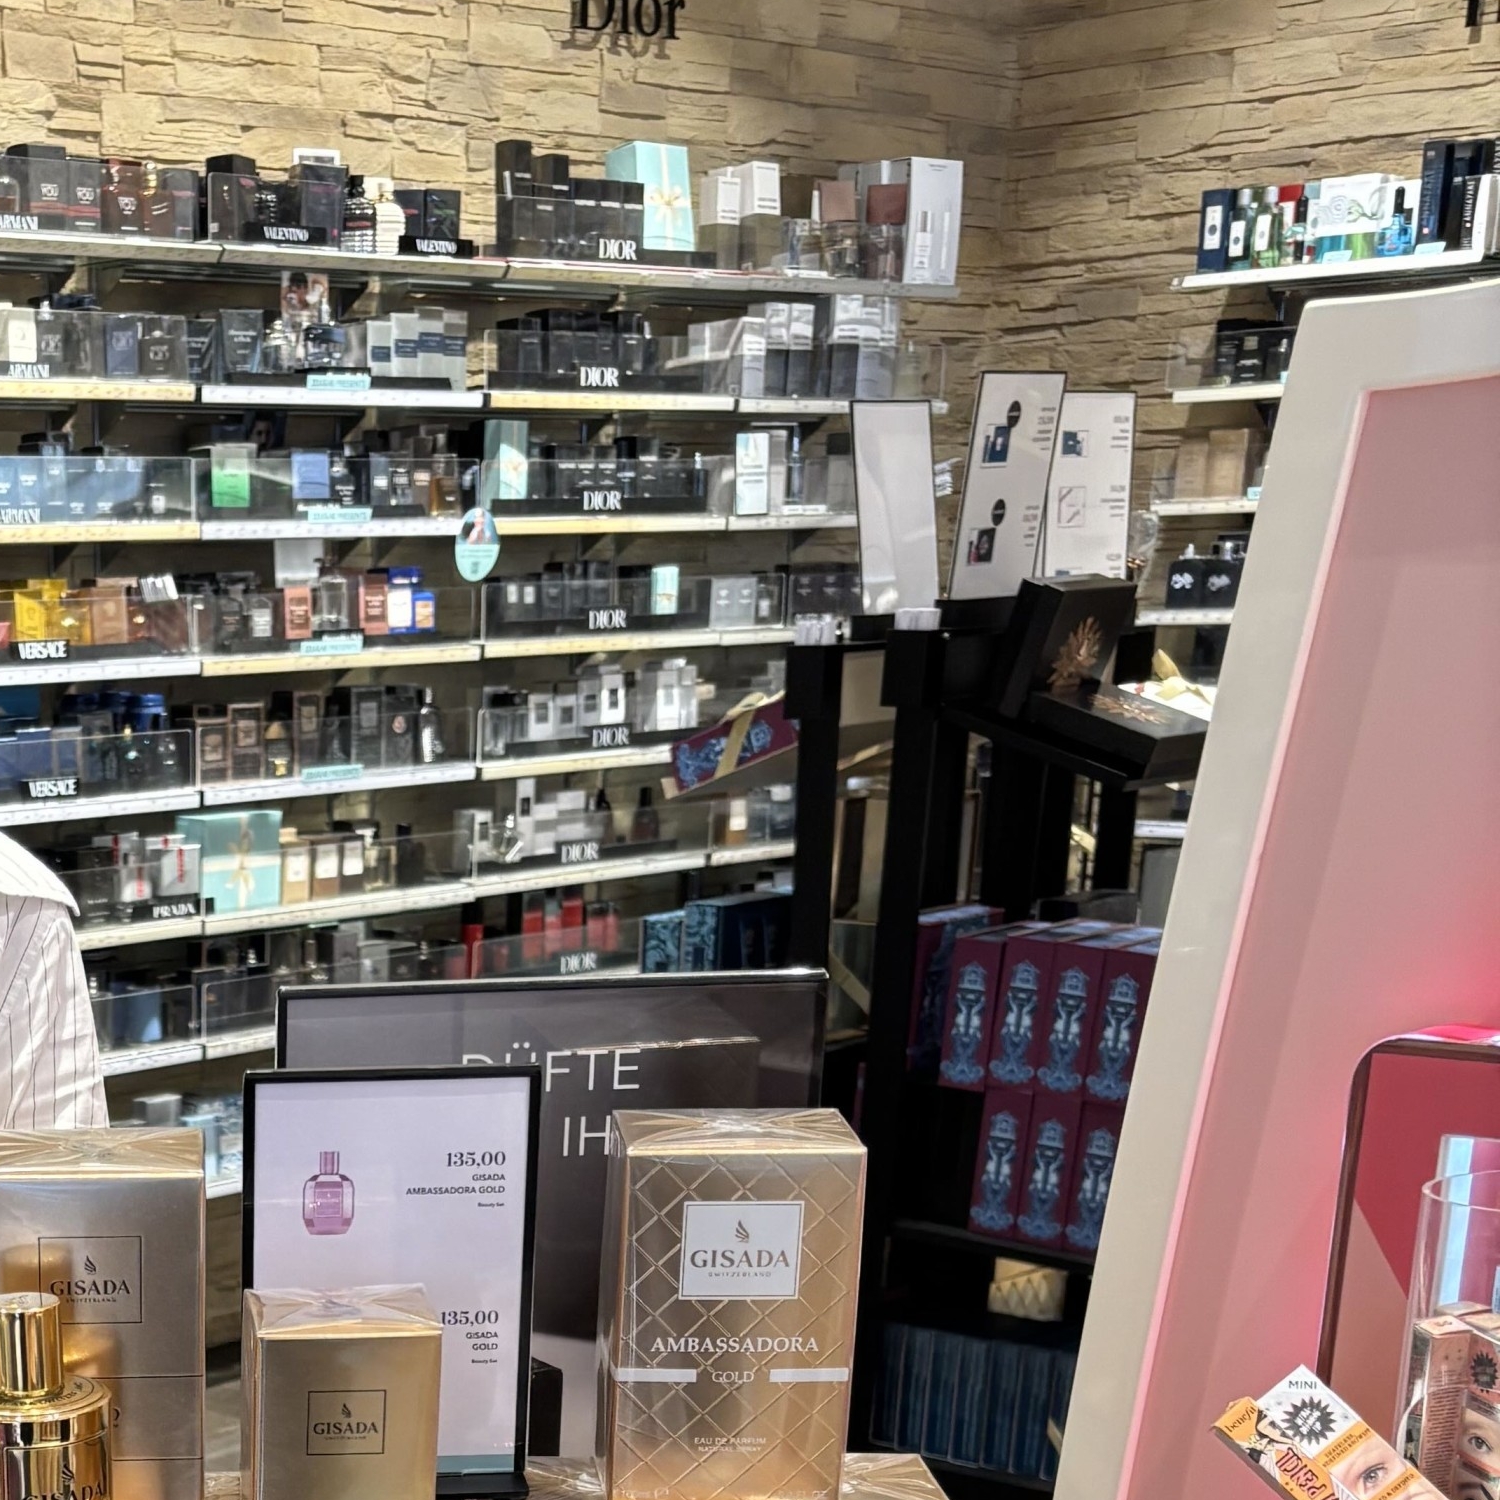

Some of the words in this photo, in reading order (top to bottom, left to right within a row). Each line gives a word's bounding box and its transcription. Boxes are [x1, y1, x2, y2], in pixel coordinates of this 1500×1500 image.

[263, 226, 310, 241] VALENTINO
[415, 239, 457, 254] VALENTINO
[599, 238, 638, 261] DIOR
[8, 364, 50, 378] ARMANI
[580, 366, 619, 388] DIOR
[583, 490, 622, 511] DIOR
[589, 609, 627, 630] DIOR
[17, 640, 68, 660] VERSACE
[592, 725, 630, 748] DIOR
[28, 778, 78, 797] VERSACE
[561, 841, 599, 863] DIOR
[560, 951, 597, 974] DIOR
[564, 1116, 611, 1157] IH
[446, 1151, 506, 1168] 135,00
[472, 1173, 506, 1182] GISADA
[406, 1186, 477, 1196] AMBASSADORA
[478, 1185, 506, 1194] GOLD
[690, 1249, 791, 1269] GISADA
[50, 1279, 131, 1296] GISADA
[441, 1310, 499, 1326] 135,00
[465, 1331, 499, 1340] GISADA
[650, 1336, 820, 1352] AMBASSADORA
[472, 1342, 499, 1351] GOLD
[711, 1370, 755, 1384] GOLD
[1288, 1380, 1318, 1390] MINI
[313, 1421, 379, 1435] GISADA
[1224, 1406, 1257, 1433] benefit
[1275, 1447, 1327, 1500] PENCIL
